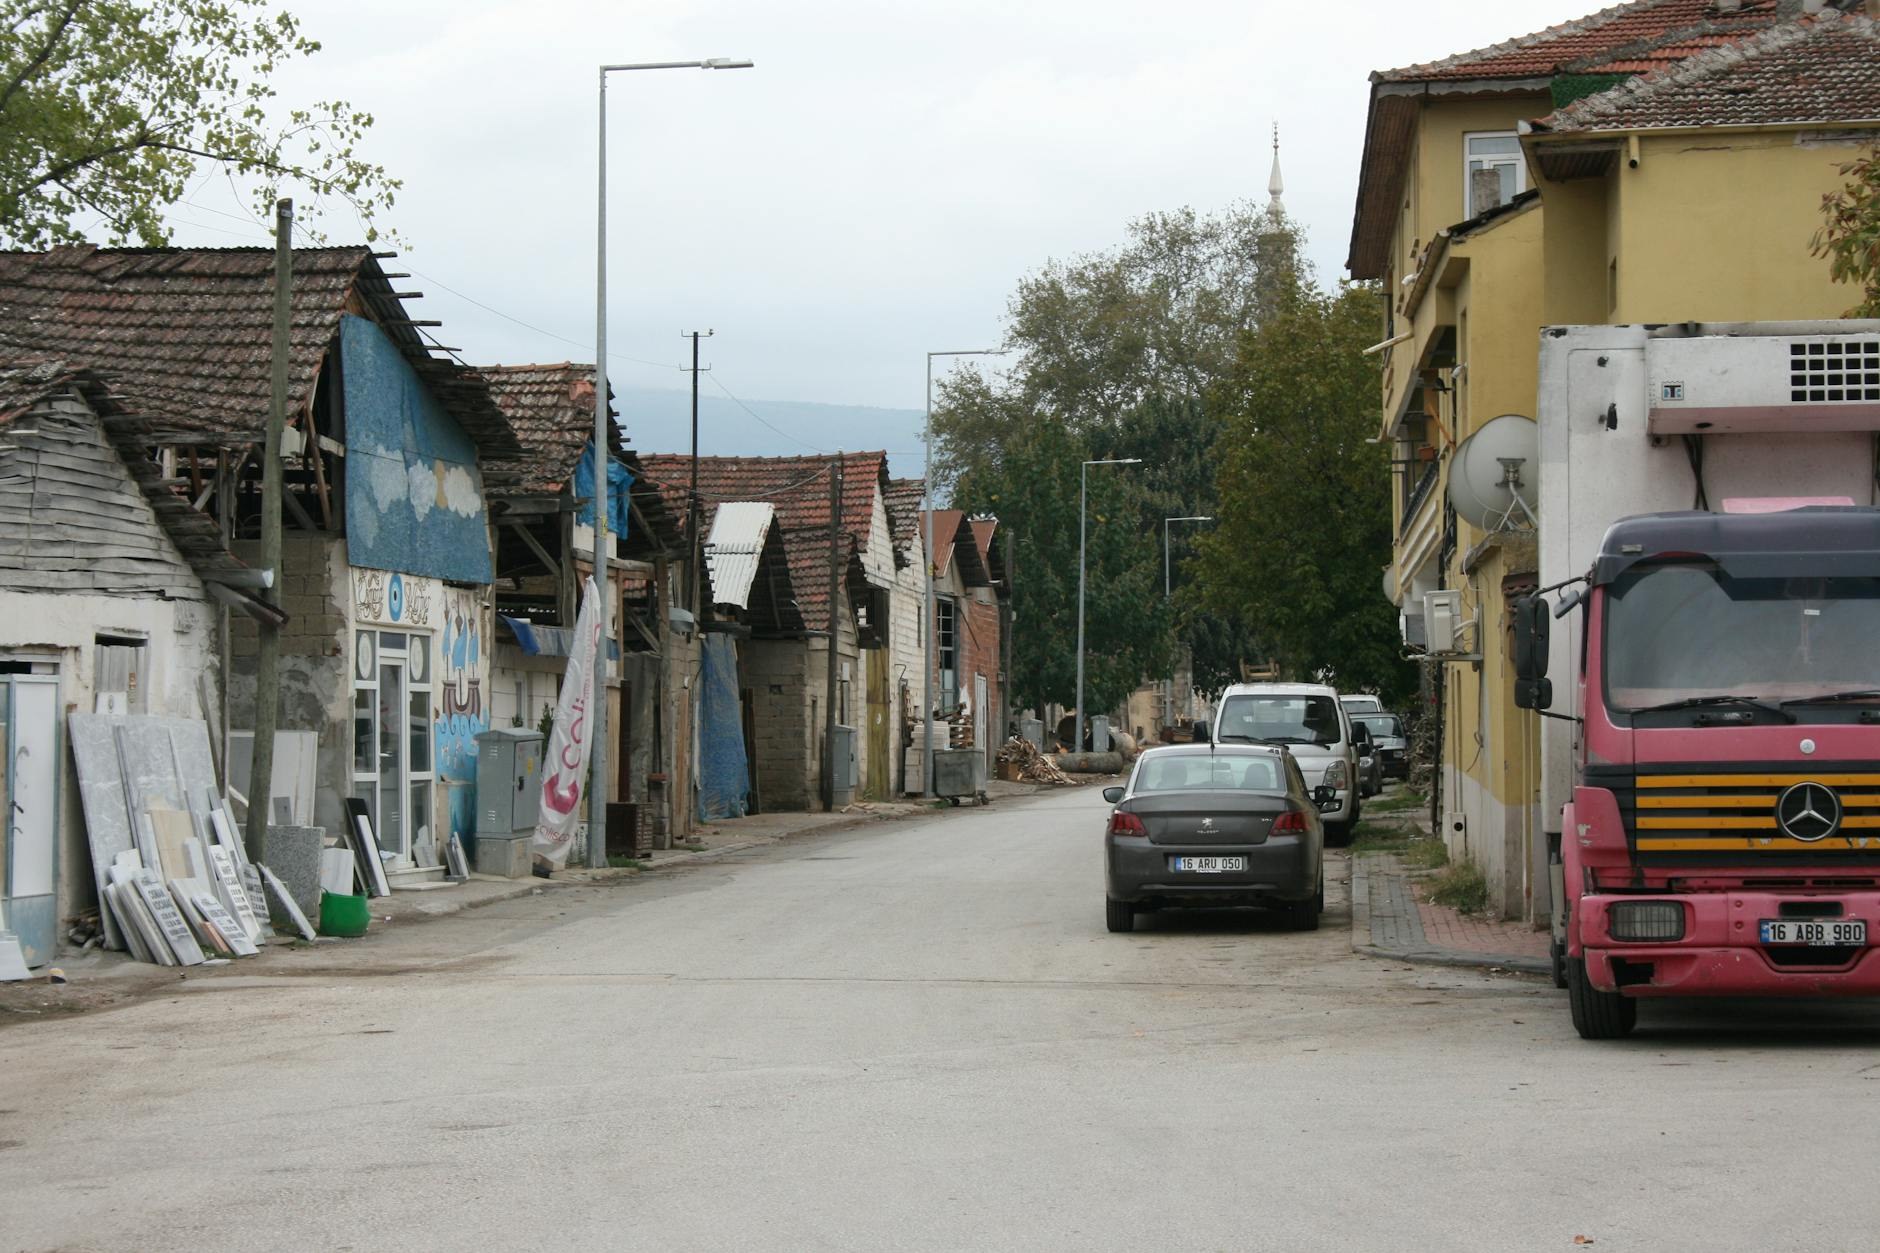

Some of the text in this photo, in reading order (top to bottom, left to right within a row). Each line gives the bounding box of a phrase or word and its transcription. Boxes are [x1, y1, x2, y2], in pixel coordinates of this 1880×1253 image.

[1182, 858, 1240, 869] 16 ARU 050
[1770, 924, 1862, 940] 16 ABB 980
